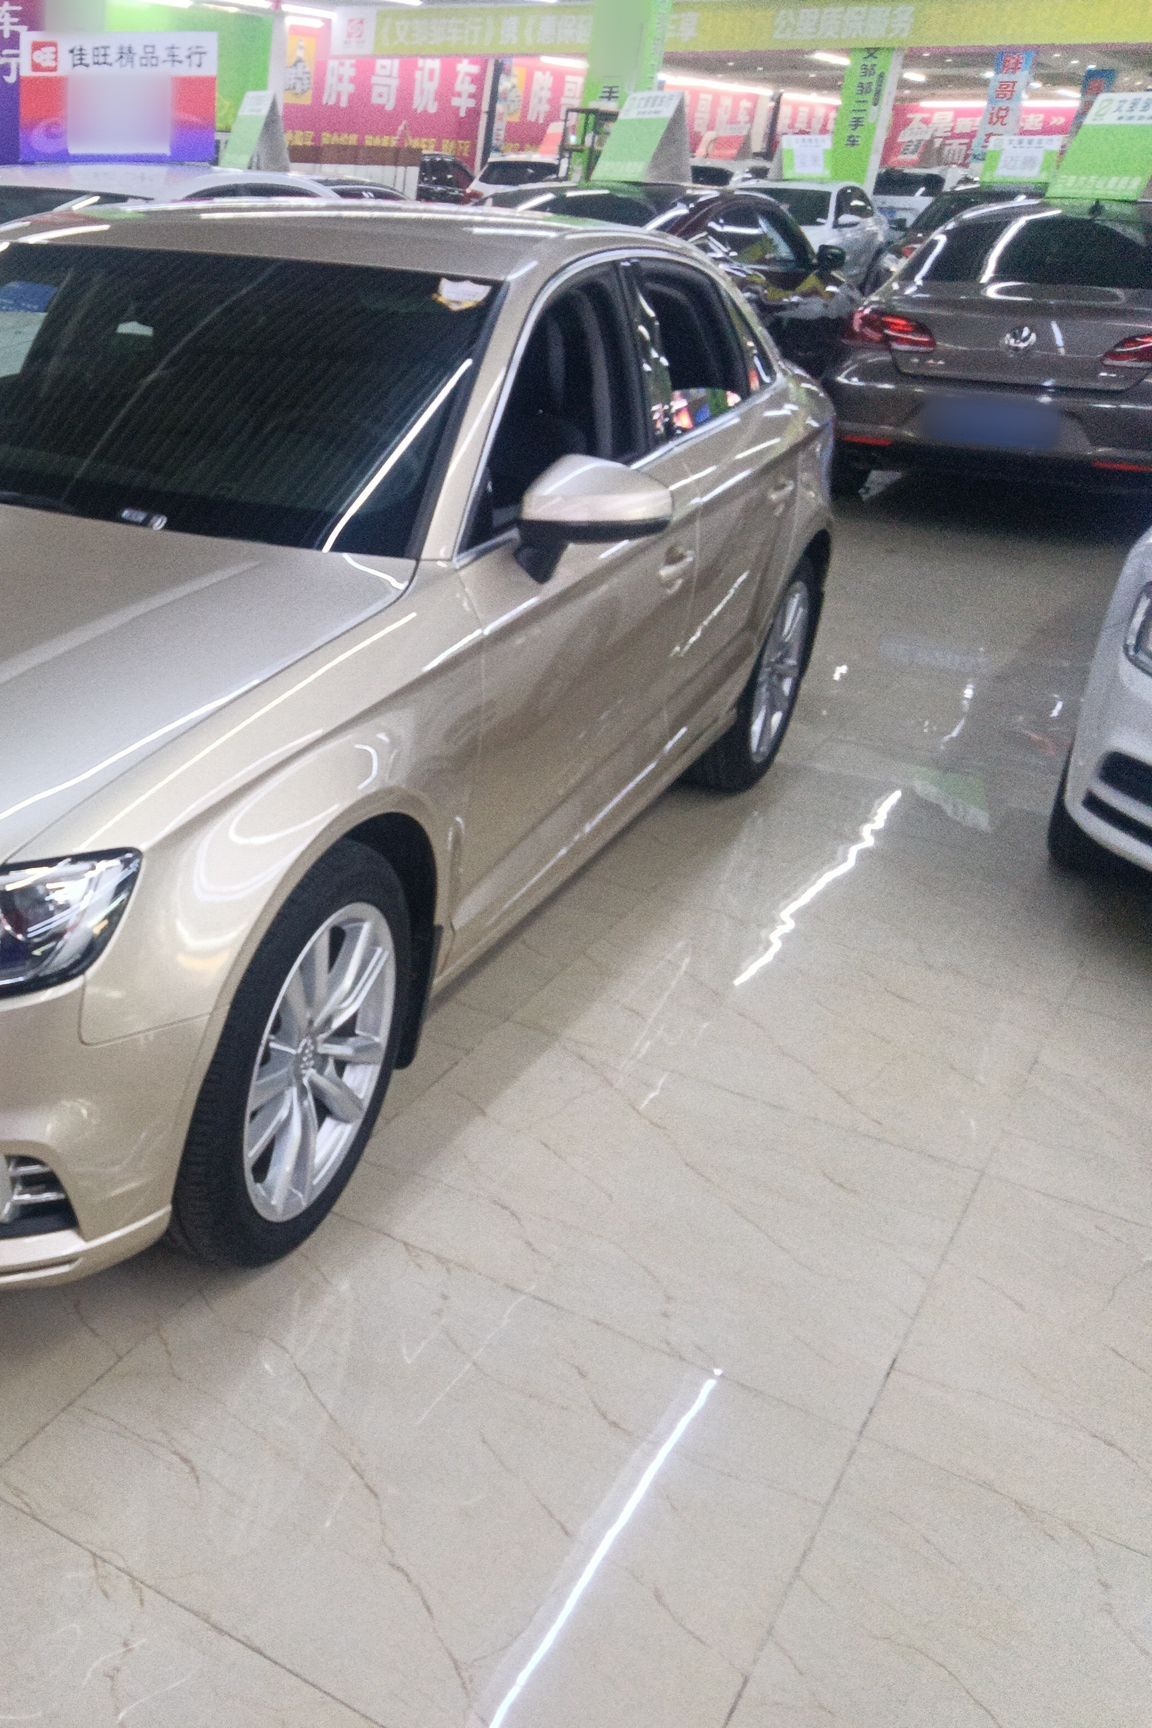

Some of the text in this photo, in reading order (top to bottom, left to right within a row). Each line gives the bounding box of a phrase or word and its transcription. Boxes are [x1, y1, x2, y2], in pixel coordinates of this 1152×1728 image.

[68, 44, 208, 68] 佳旺精品车行
[322, 58, 480, 118] 胖哥说车
